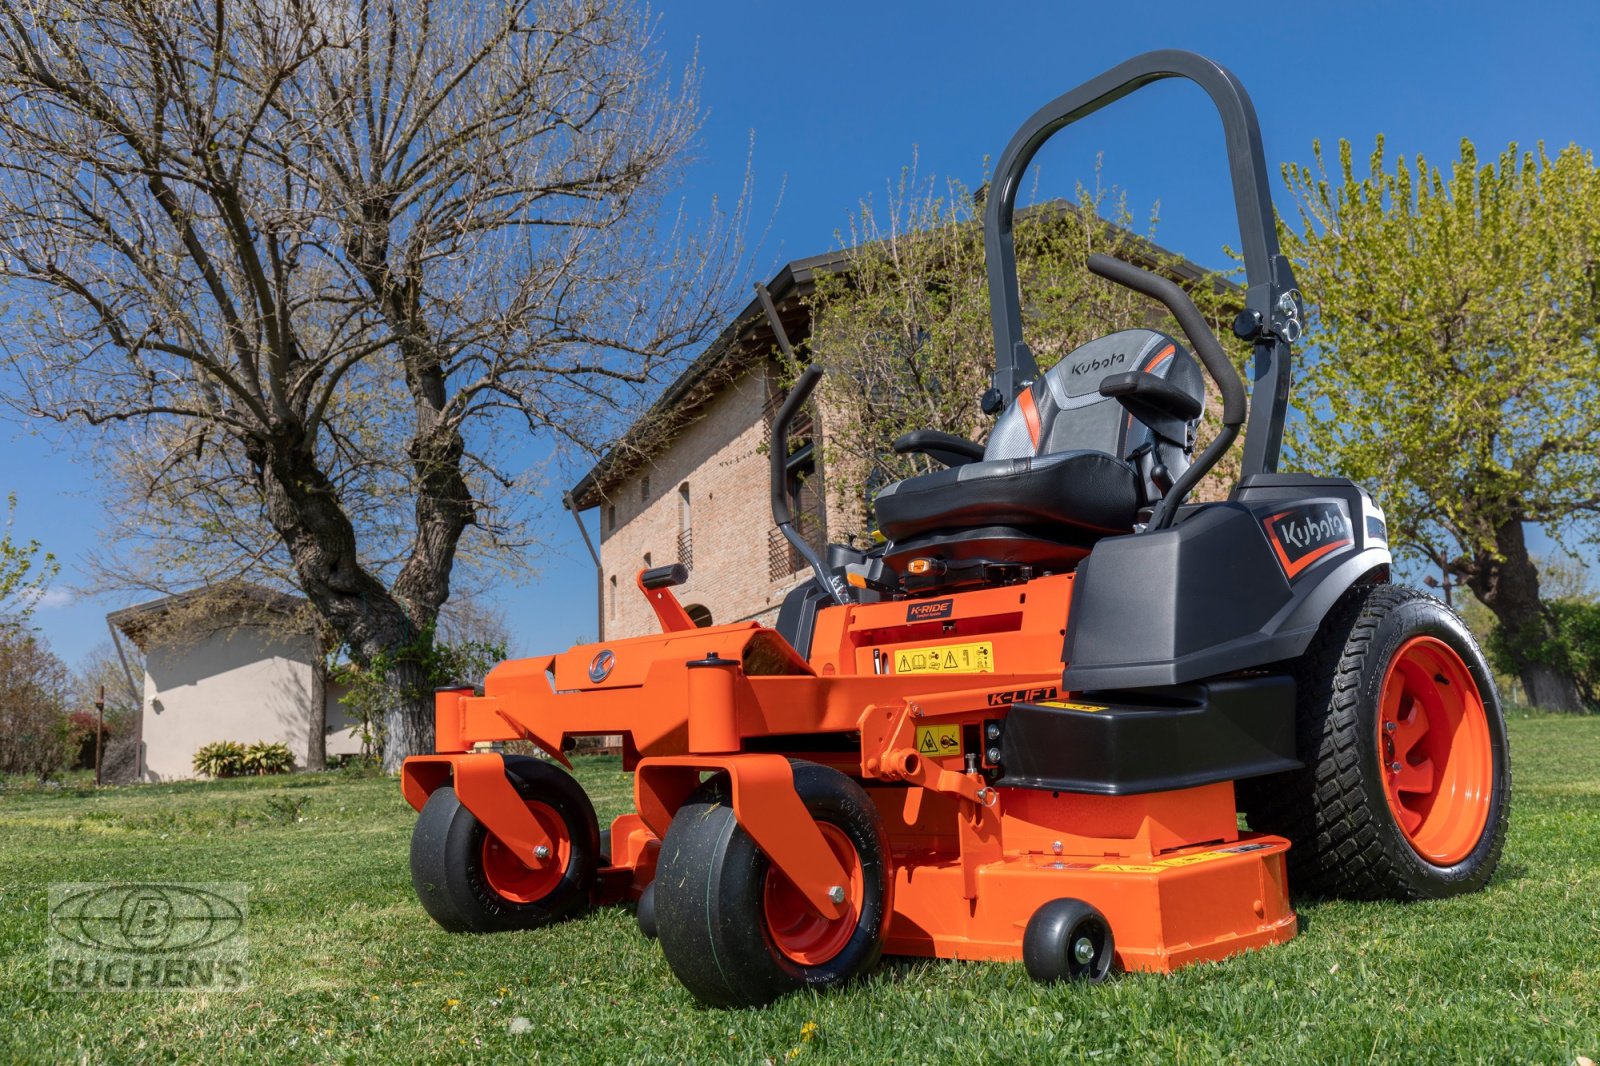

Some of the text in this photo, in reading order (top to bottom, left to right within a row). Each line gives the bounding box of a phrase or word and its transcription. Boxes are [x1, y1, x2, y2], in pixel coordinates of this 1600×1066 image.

[1071, 353, 1126, 375] Kubota
[1281, 510, 1345, 548] Kubota
[910, 602, 949, 615] K-RIDE
[990, 687, 1056, 706] K-LIFT
